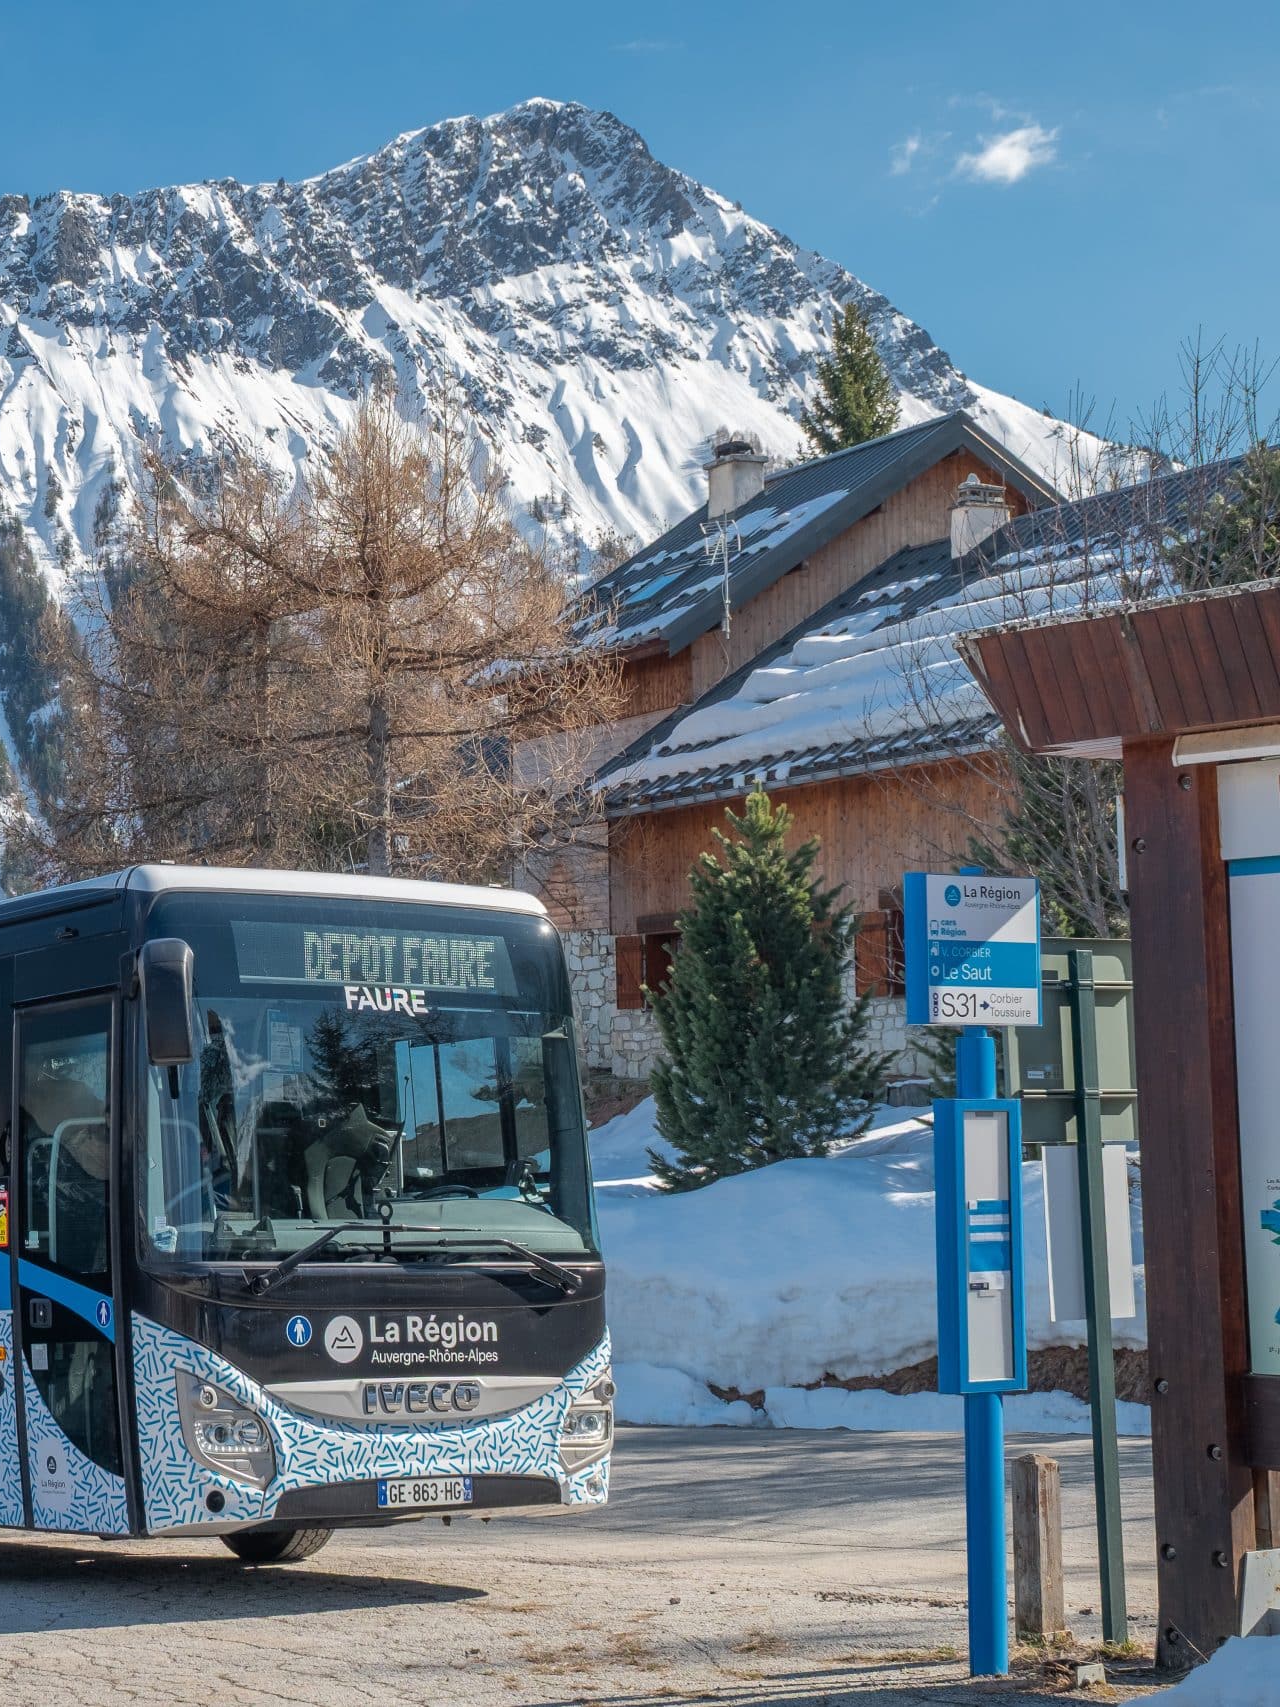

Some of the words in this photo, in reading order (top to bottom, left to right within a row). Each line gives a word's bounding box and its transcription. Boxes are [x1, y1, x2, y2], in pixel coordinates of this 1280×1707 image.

[964, 885, 977, 898] La
[980, 886, 1021, 901] Région
[941, 928, 966, 937] Région
[303, 931, 397, 983] DEPOT
[402, 936, 495, 989] FAURE
[951, 948, 991, 958] CORBIER
[942, 963, 959, 980] Le
[961, 964, 992, 980] Saut
[344, 986, 429, 1017] FAURE
[941, 993, 977, 1018] S31
[989, 993, 1023, 1004] Corbier
[990, 1007, 1032, 1018] Toussuire
[369, 1315, 400, 1343] La
[406, 1314, 498, 1349] Région
[371, 1347, 499, 1366] Auvergne-Rhône-Alpes
[363, 1380, 481, 1415] IVECO
[41, 1480, 48, 1488] La
[48, 1479, 66, 1489] Région
[389, 1481, 462, 1504] GE-863-HG
